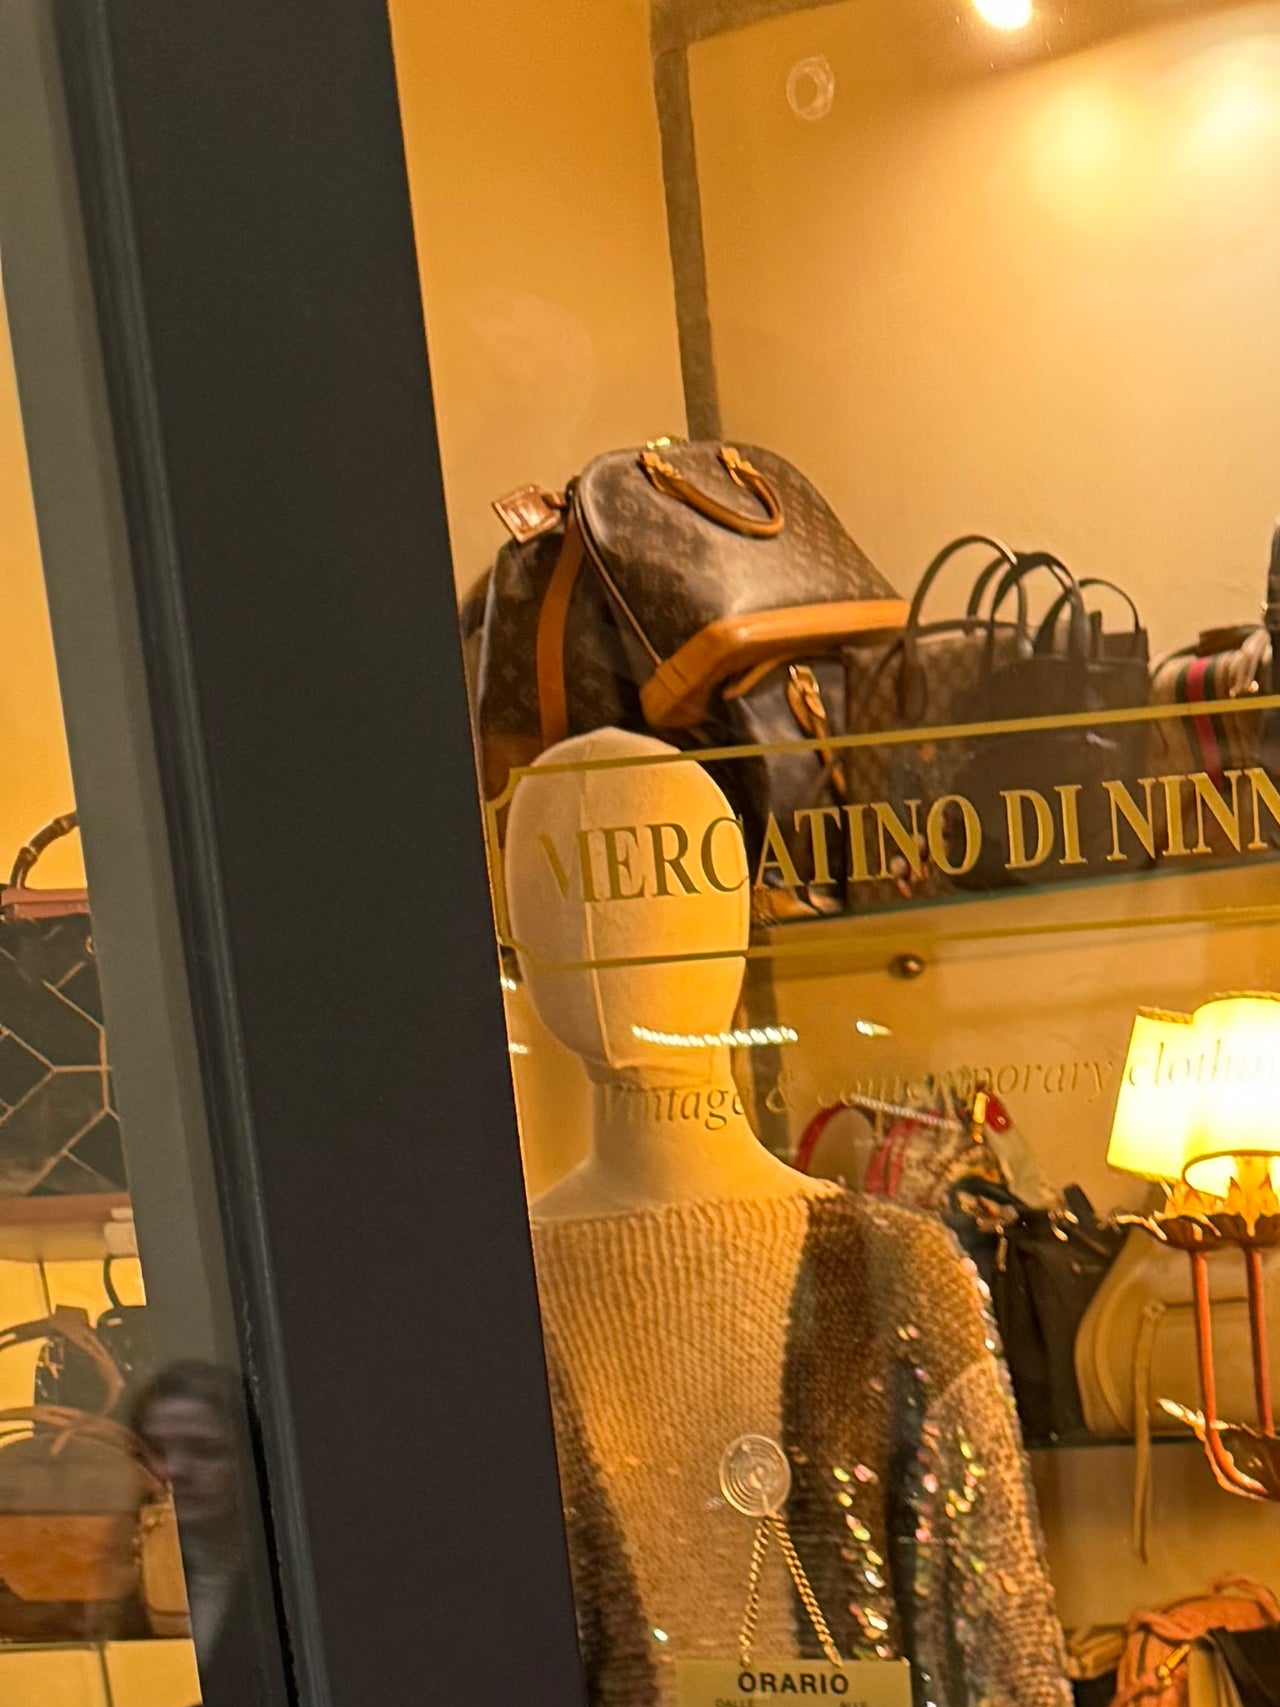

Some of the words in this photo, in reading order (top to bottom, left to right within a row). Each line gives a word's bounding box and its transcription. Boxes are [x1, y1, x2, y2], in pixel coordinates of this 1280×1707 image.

[539, 794, 982, 901] MERCATINO
[1000, 784, 1088, 869] DI
[738, 1672, 849, 1694] ORARIO
